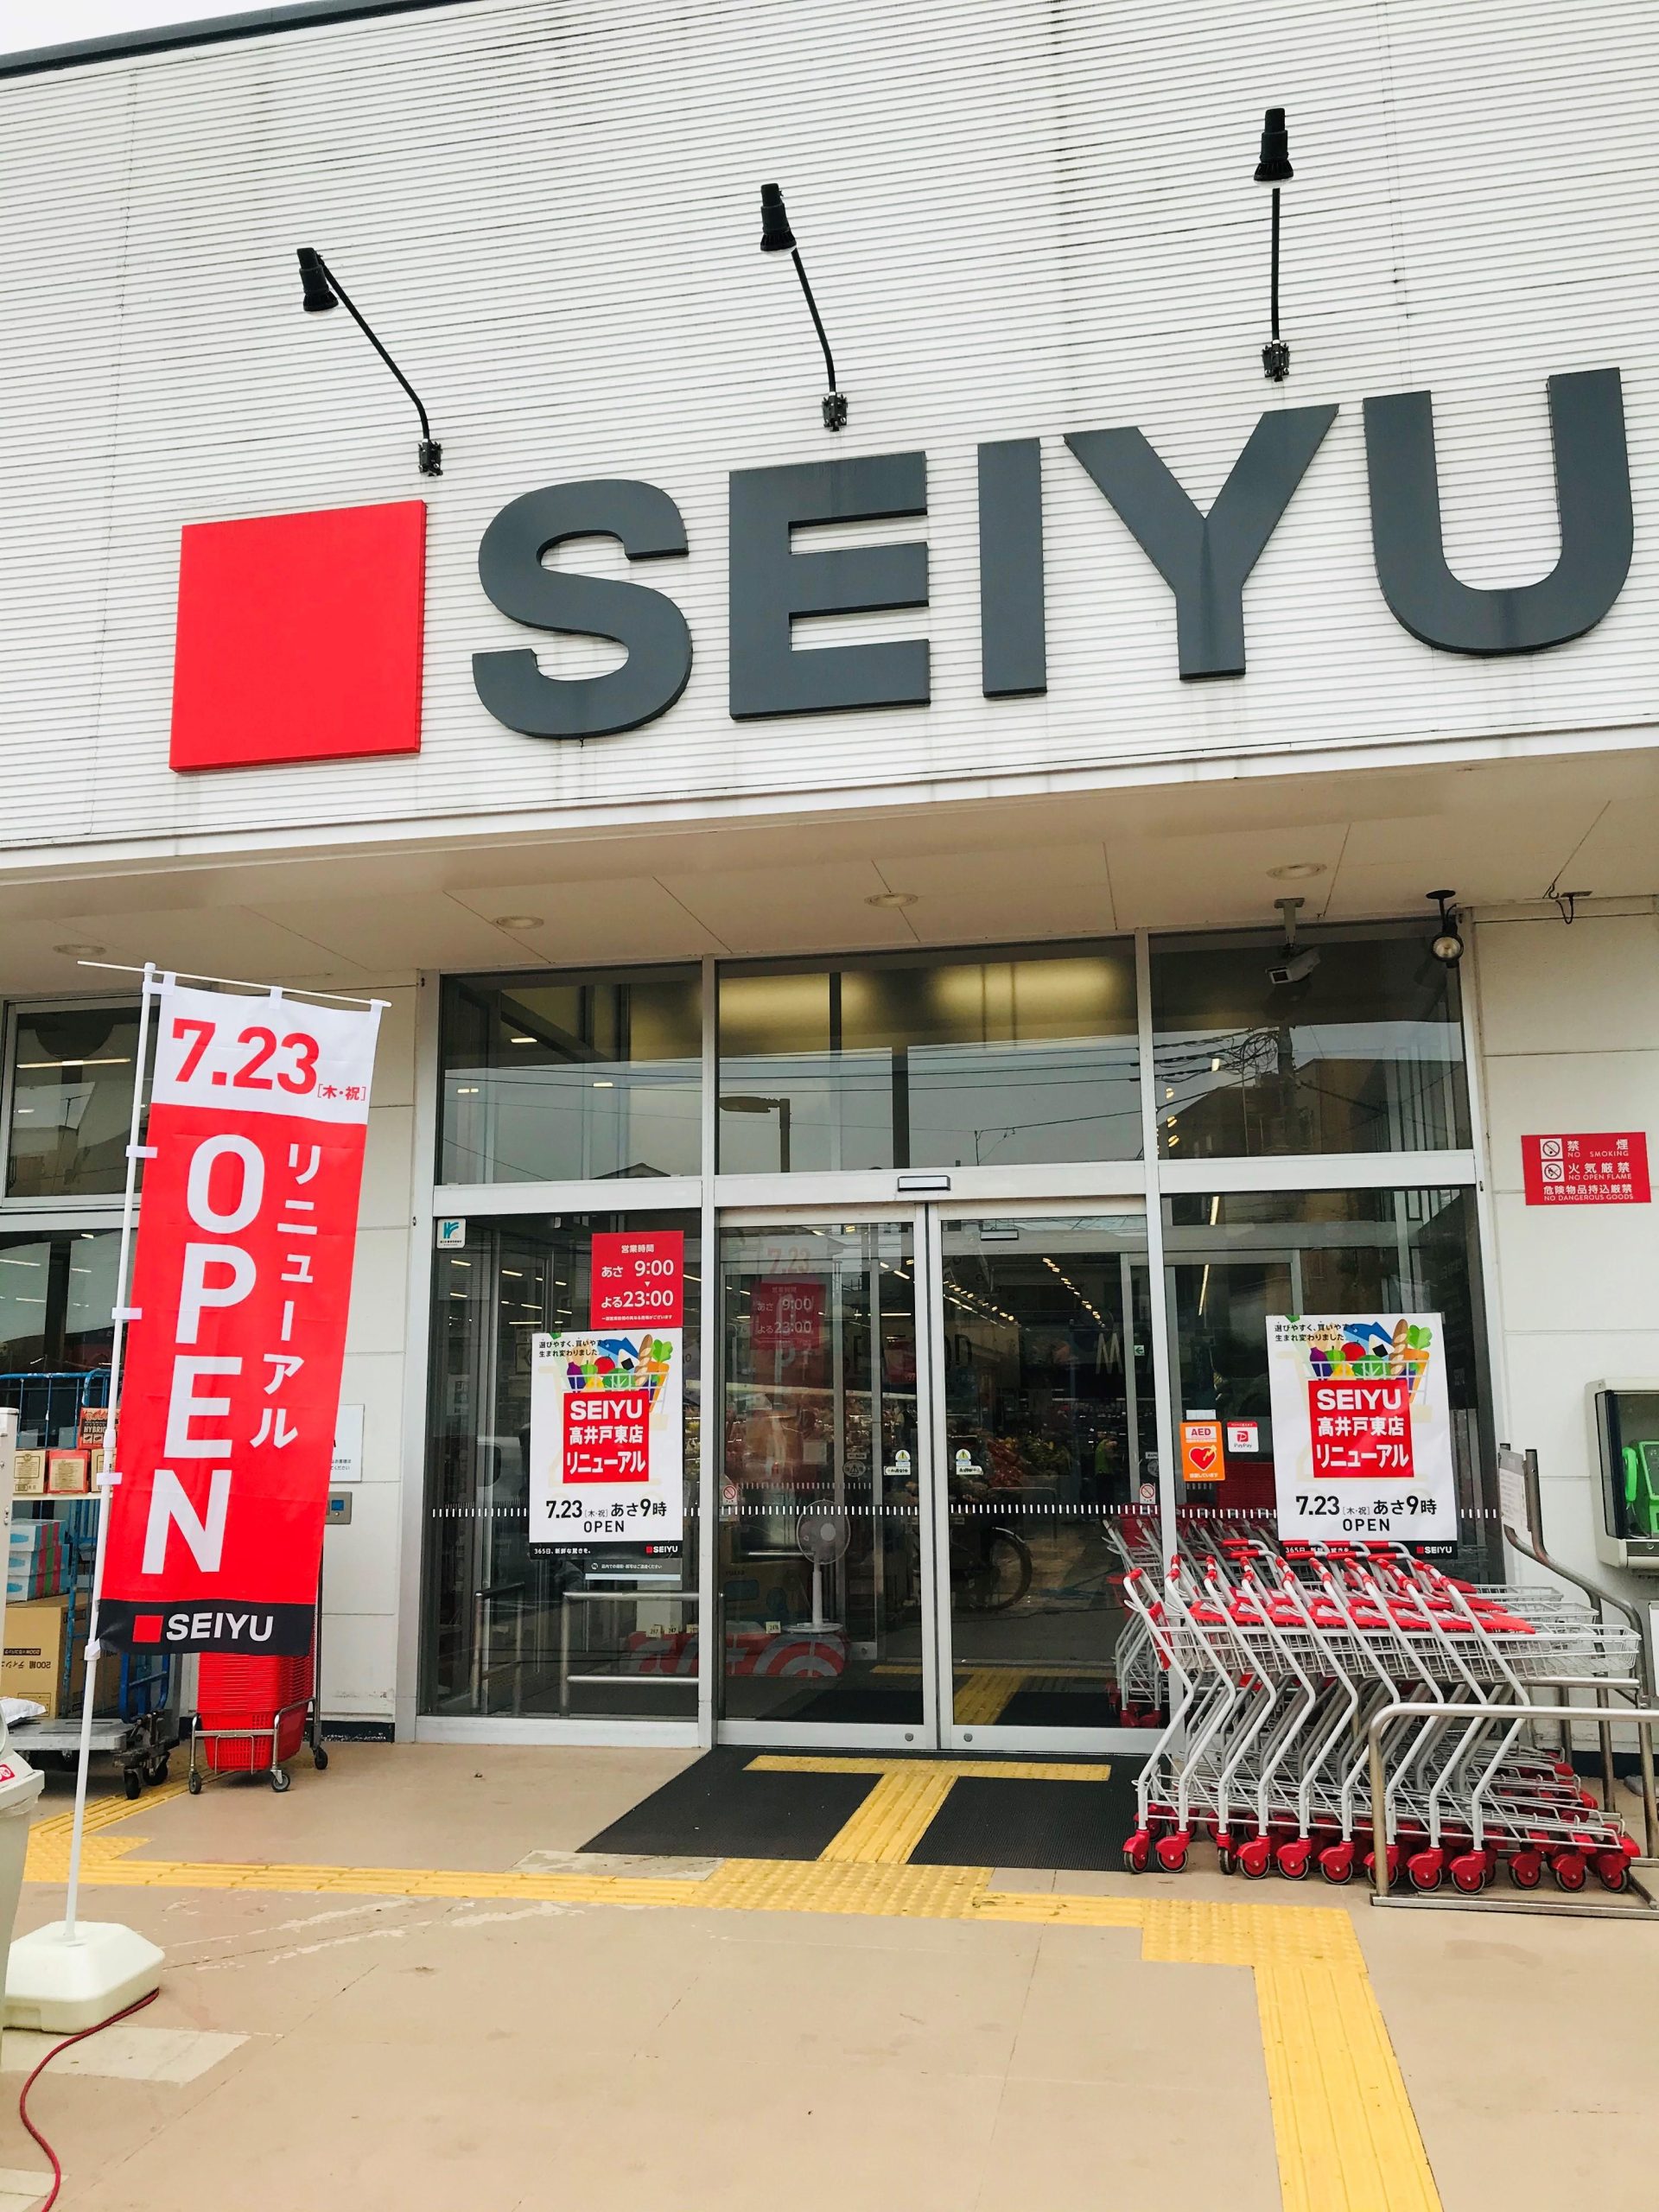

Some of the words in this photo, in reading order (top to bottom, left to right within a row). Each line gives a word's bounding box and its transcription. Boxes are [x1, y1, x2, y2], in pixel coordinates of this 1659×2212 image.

[472, 366, 1635, 740] SEIYU
[172, 1018, 320, 1095] 7.23
[621, 1244, 655, 1253] 営業時間
[601, 1266, 623, 1277] あさ
[634, 1259, 674, 1276] 9:00
[250, 1143, 322, 1450] リニューアル
[142, 1134, 265, 1574] OPEN
[569, 1399, 643, 1421] SEIYU
[1317, 1389, 1402, 1410] SEIYU
[569, 1425, 644, 1446] 高井戸東店
[1317, 1416, 1404, 1437] 高井戸東店
[567, 1450, 645, 1474] リニューアル
[1316, 1443, 1409, 1468] リニューアル
[545, 1500, 582, 1519] 7.23
[1296, 1496, 1339, 1516] 7.23
[583, 1520, 625, 1533] OPEN
[1343, 1518, 1390, 1531] OPEN
[166, 1612, 274, 1642] SEIYU
